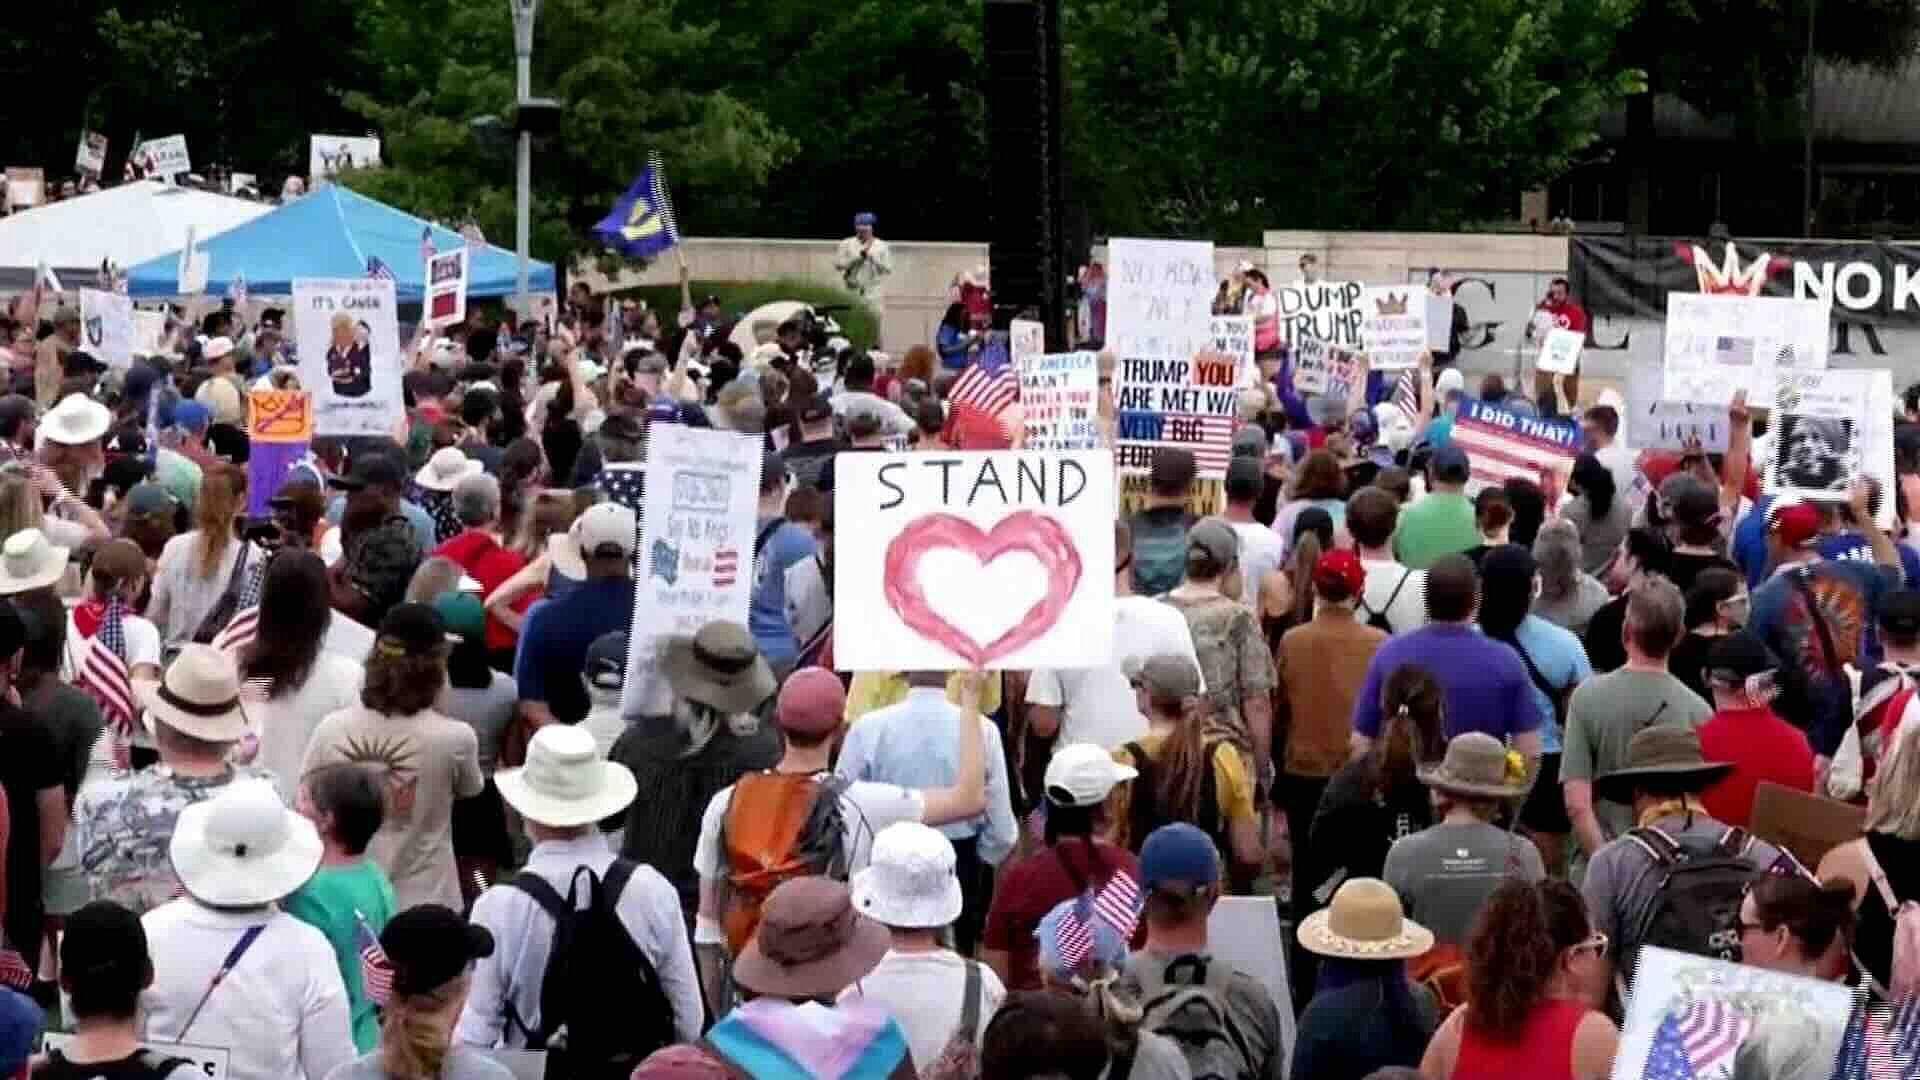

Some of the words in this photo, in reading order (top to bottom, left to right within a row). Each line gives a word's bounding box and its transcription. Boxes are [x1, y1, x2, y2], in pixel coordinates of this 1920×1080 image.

[1279, 281, 1361, 315] DUMP
[1794, 262, 1882, 310] NO
[1195, 360, 1235, 387] YOU
[1119, 386, 1154, 411] ARE
[1161, 388, 1200, 414] MET
[1119, 417, 1165, 441] VERY
[1171, 419, 1204, 442] BIG
[1471, 403, 1479, 418] I
[1480, 407, 1515, 429] DID
[1519, 417, 1574, 446] THAT!
[877, 456, 1087, 511] STAND
